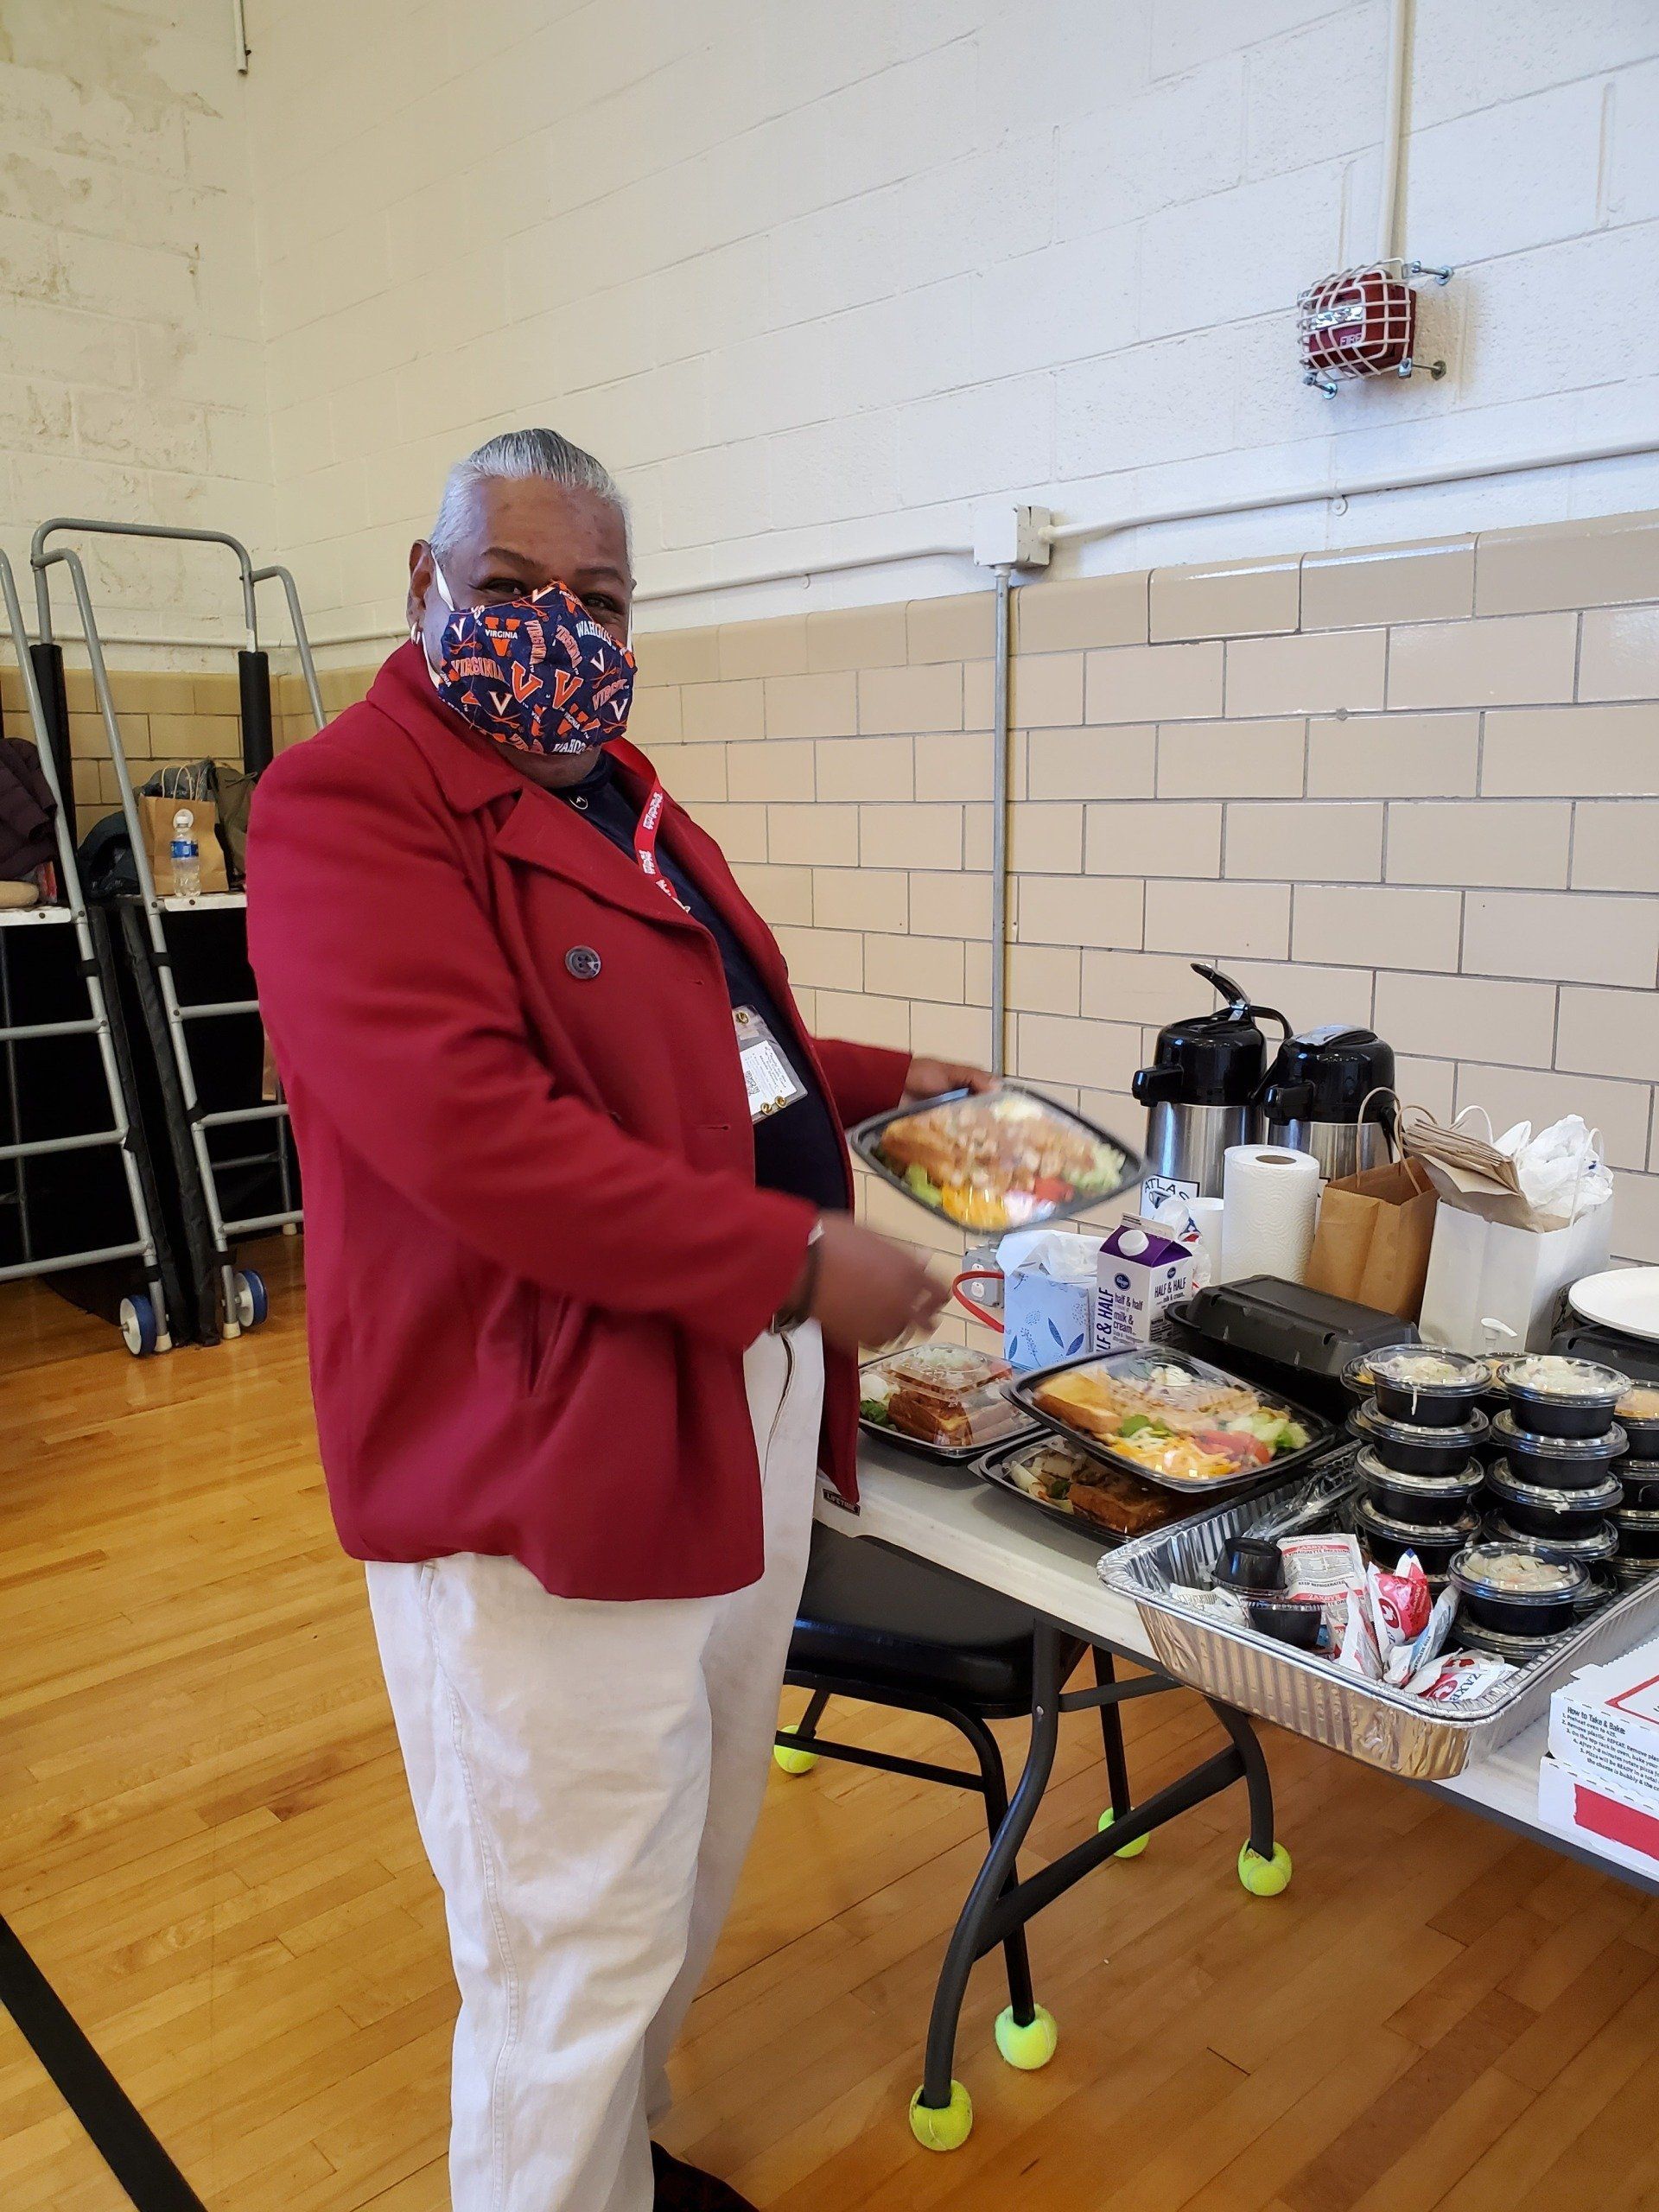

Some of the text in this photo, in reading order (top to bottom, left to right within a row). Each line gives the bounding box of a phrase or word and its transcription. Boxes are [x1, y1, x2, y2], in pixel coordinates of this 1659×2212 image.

[485, 628, 518, 639] VIRGINIA
[1154, 1277, 1186, 1298] HALF & HALF
[1097, 1287, 1114, 1320] HALF
[1115, 1293, 1125, 1306] half
[1126, 1296, 1130, 1307] &
[1132, 1298, 1143, 1311] half
[1113, 1311, 1134, 1325] milk &
[1096, 1322, 1112, 1334] &
[1567, 1707, 1580, 1716] How
[1589, 1714, 1603, 1726] Take
[1627, 1745, 1647, 1757] Remove
